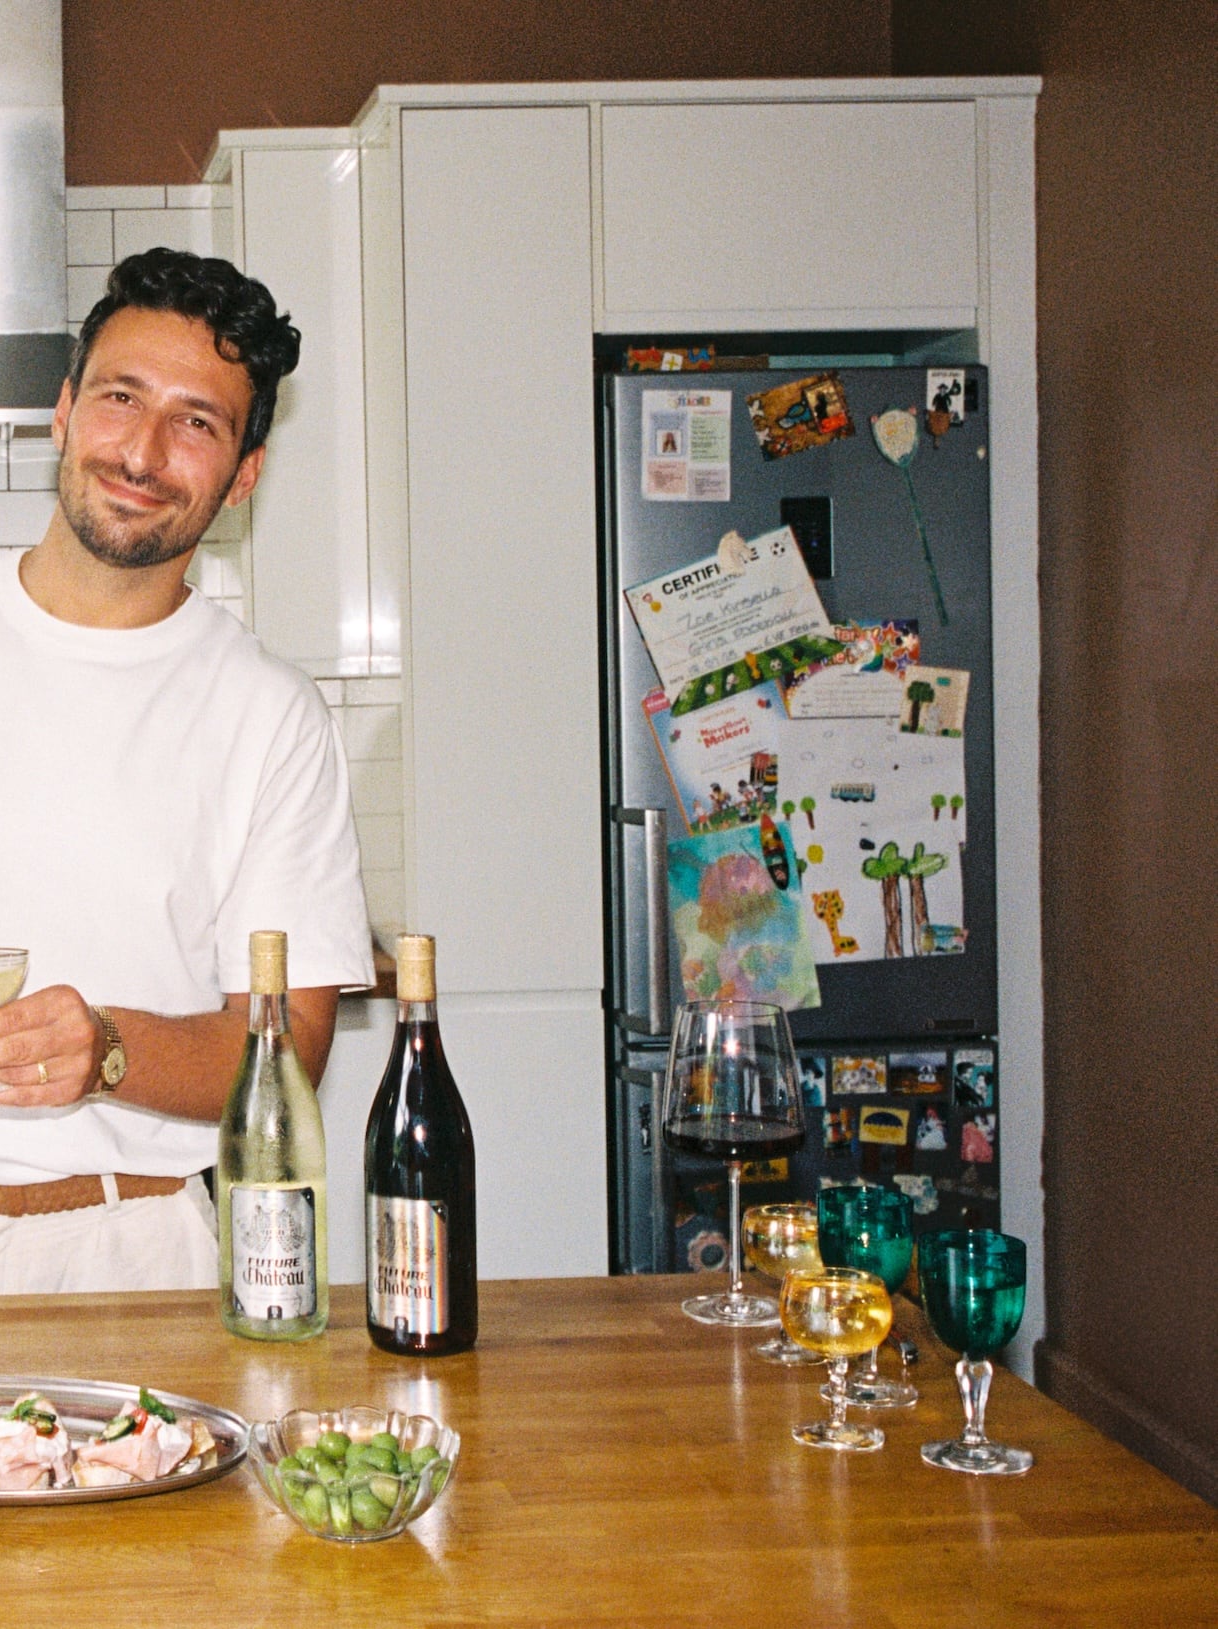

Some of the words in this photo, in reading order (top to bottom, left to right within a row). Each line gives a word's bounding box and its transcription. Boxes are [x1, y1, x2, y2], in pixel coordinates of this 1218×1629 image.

[661, 547, 760, 596] CERTIFIE
[703, 725, 751, 749] Makers
[248, 1257, 301, 1268] FUTURE
[243, 1267, 305, 1286] Château
[378, 1265, 429, 1280] FUTURE
